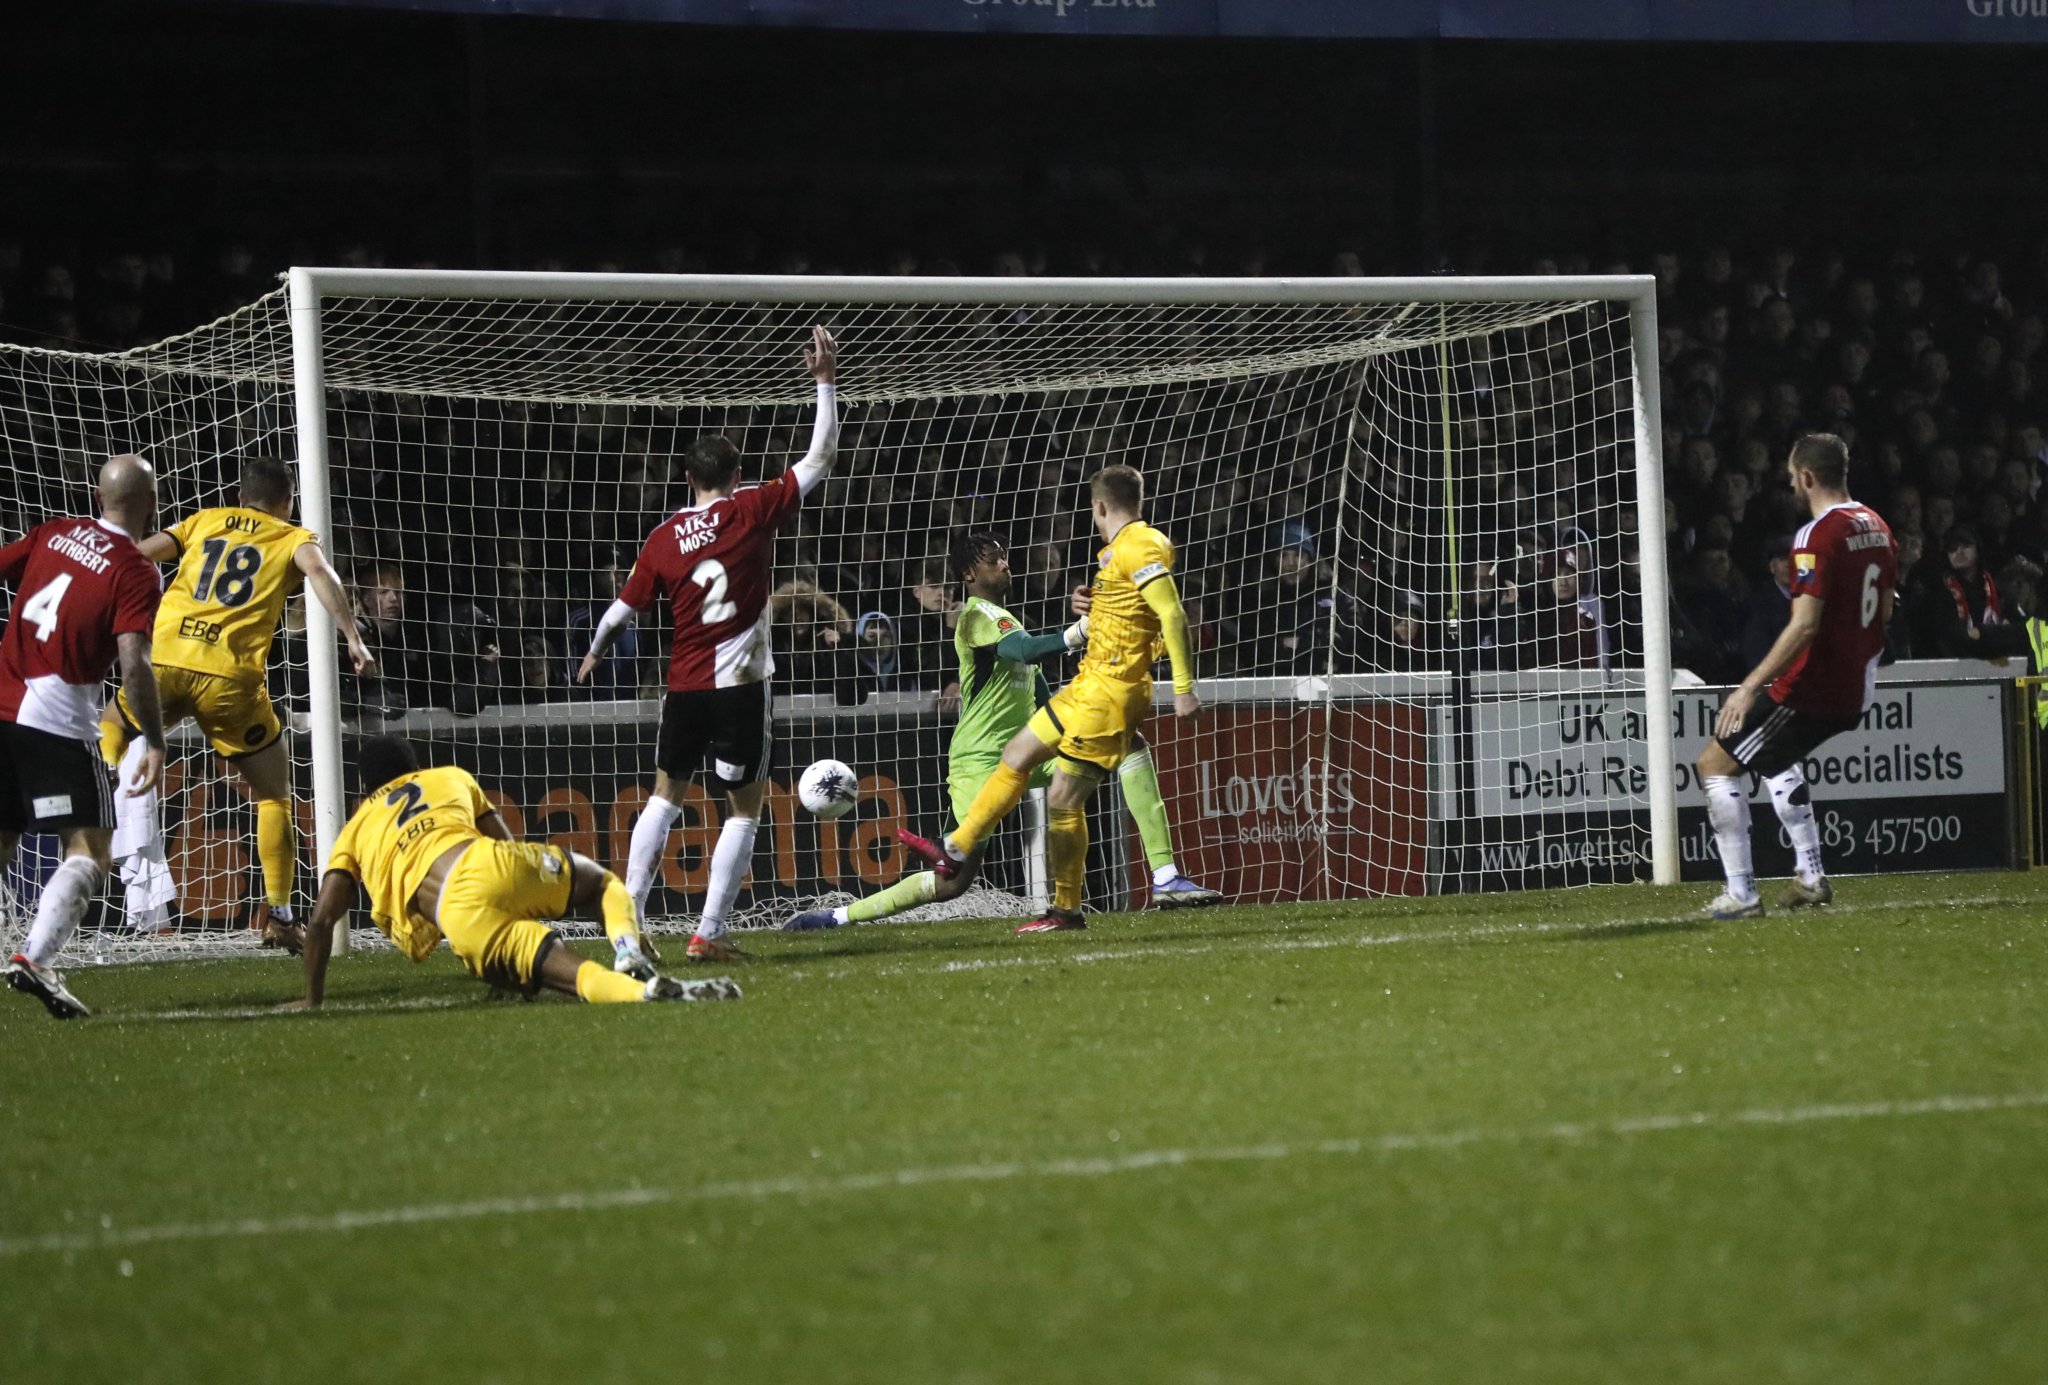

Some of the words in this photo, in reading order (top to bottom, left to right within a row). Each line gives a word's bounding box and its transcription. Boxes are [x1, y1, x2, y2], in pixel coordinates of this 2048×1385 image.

[67, 525, 115, 554] MKJ
[673, 512, 720, 539] MKJ
[679, 529, 717, 555] MOSS
[47, 534, 111, 575] CUTHBERT
[193, 538, 263, 608] 18
[21, 572, 73, 643] 4
[691, 559, 737, 625] 2
[1861, 563, 1881, 629] 6
[179, 616, 222, 643] EBB
[1557, 703, 1610, 744] UK
[1201, 760, 1354, 817] Lovetts
[1508, 759, 1590, 800] Debt
[1803, 743, 1963, 787] pecialists
[387, 782, 429, 828] 2
[397, 817, 435, 852] EBB
[1240, 820, 1322, 844] solicitors
[1778, 810, 1856, 857] 083
[1865, 815, 1961, 855] 457500
